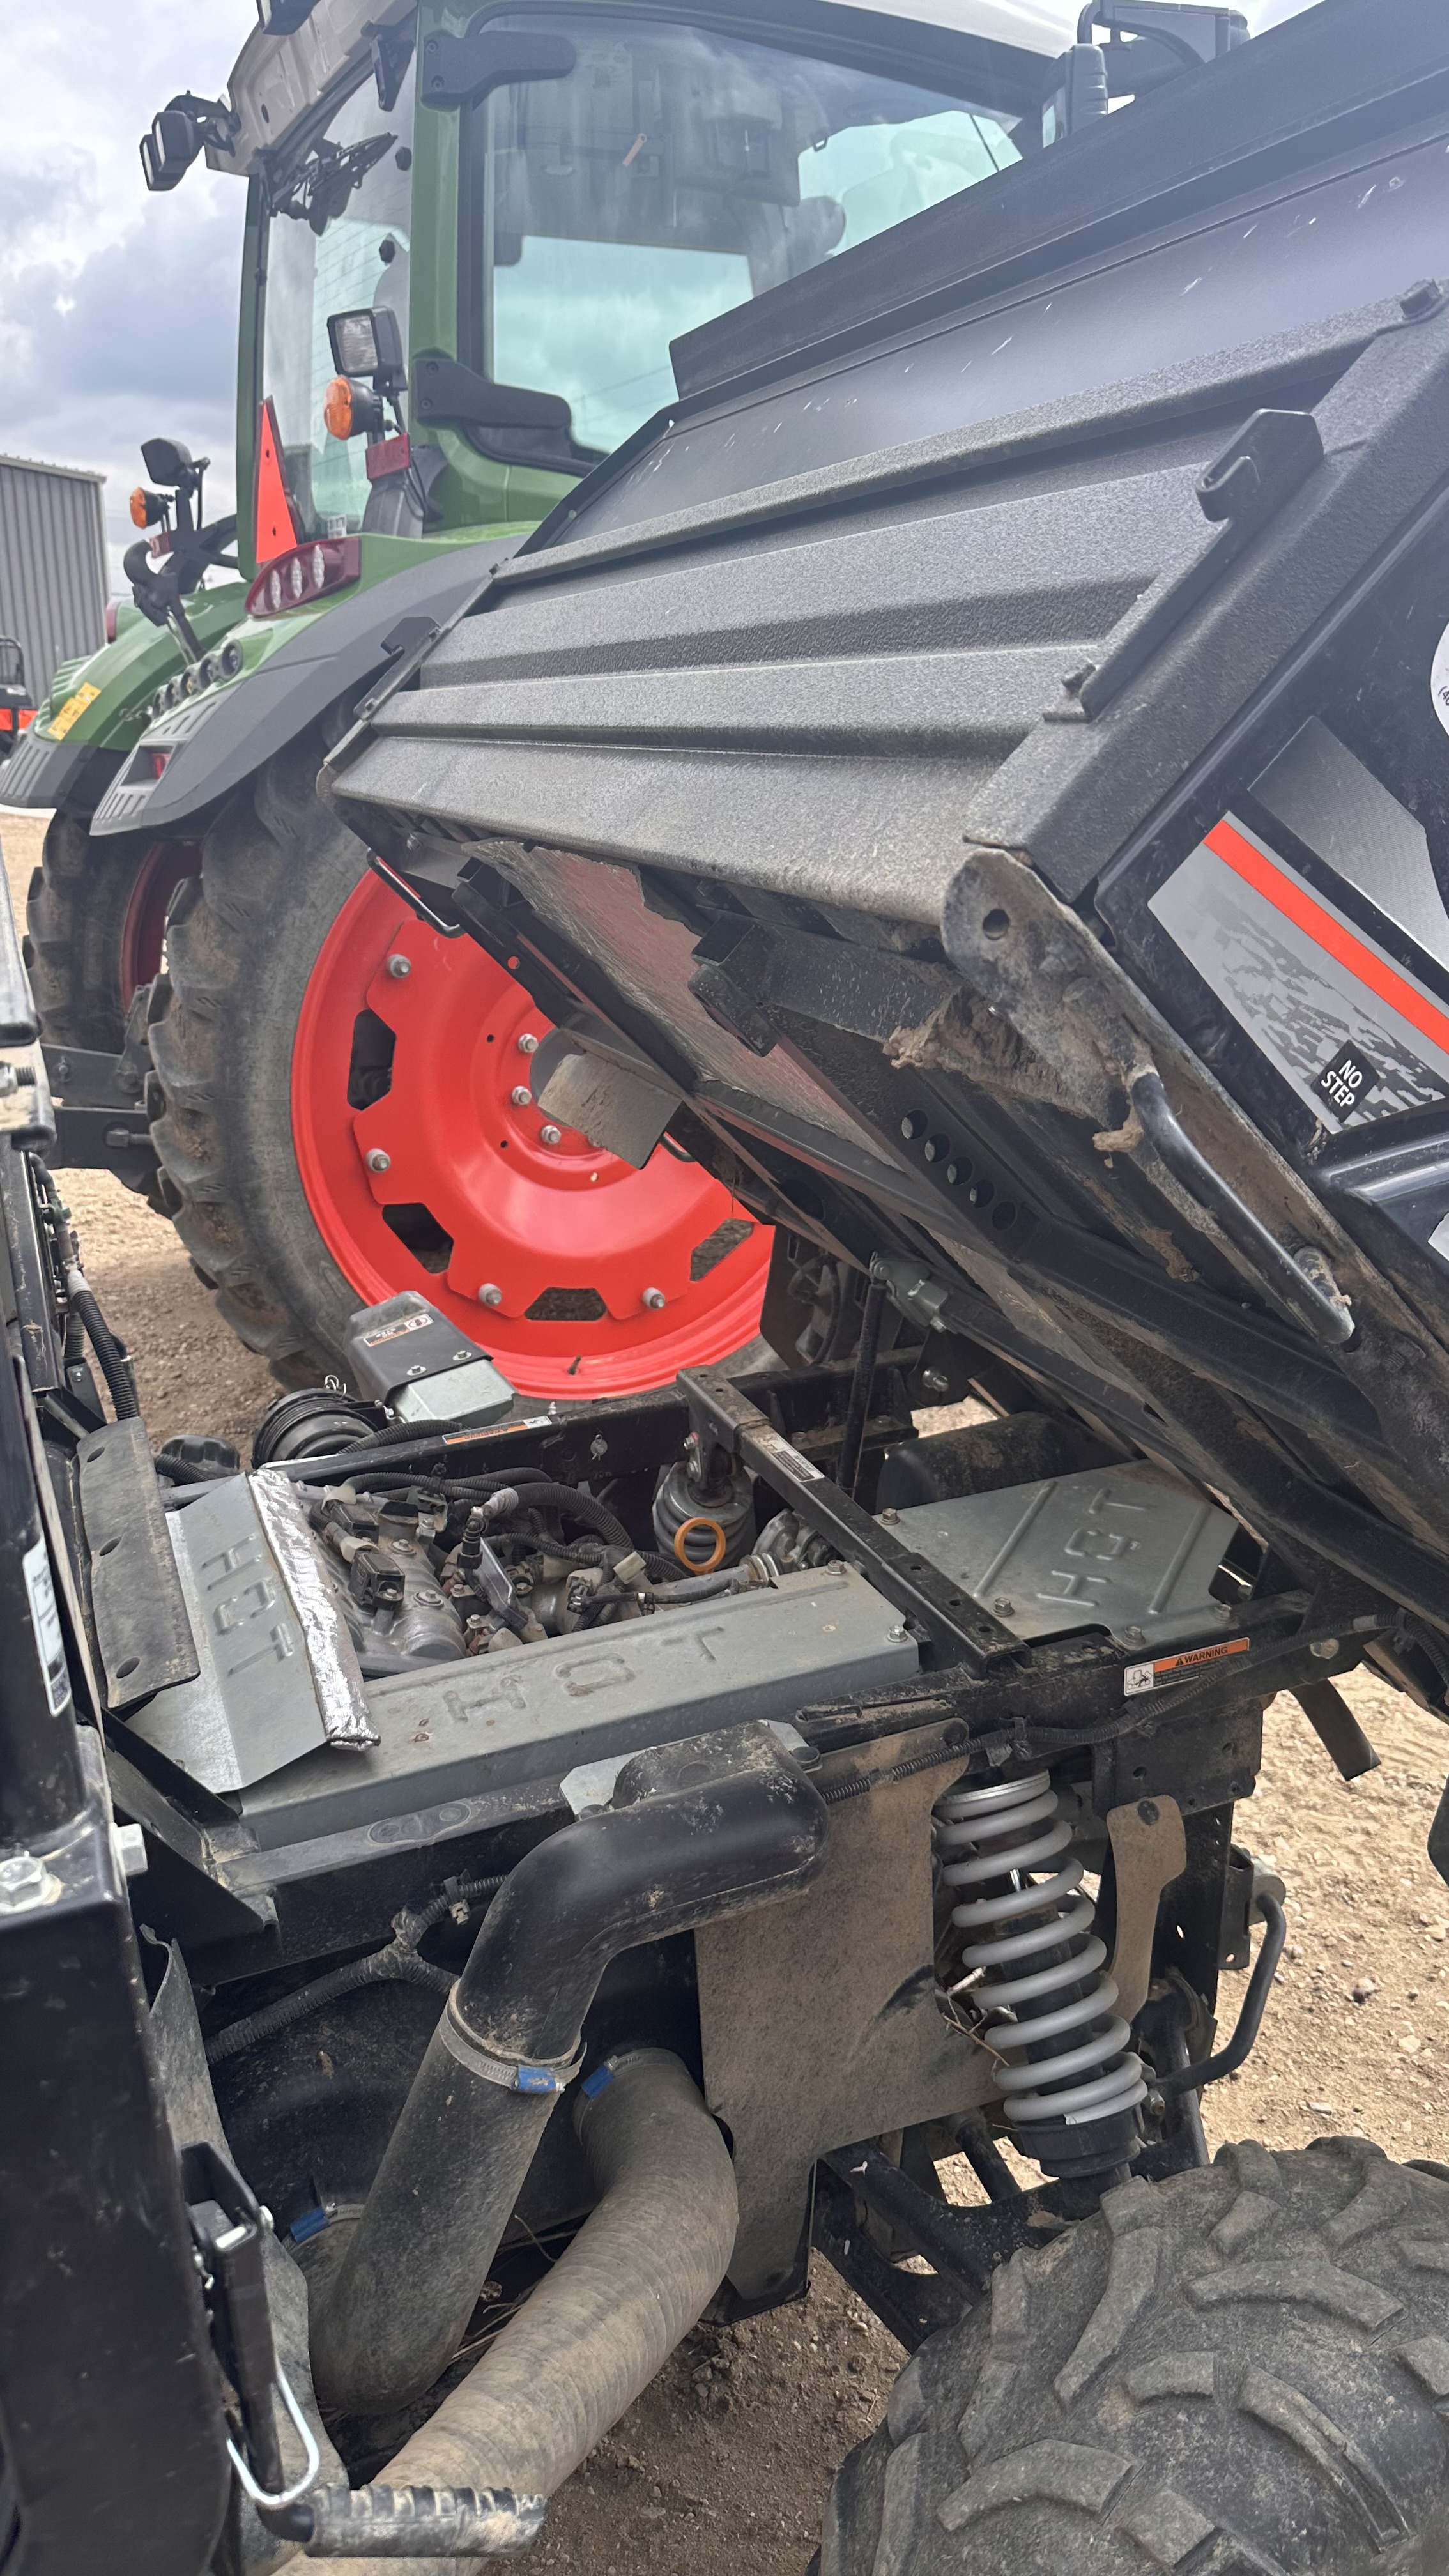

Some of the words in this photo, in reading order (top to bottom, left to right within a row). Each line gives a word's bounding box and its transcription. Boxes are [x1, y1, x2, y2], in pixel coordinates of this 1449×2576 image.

[1321, 1071, 1355, 1107] STEP
[1338, 1059, 1363, 1088] NO
[1036, 1487, 1153, 1606] HOT
[201, 1535, 293, 1676] HOT
[443, 1627, 724, 1722] HOT
[1184, 1646, 1228, 1663] WARNING
